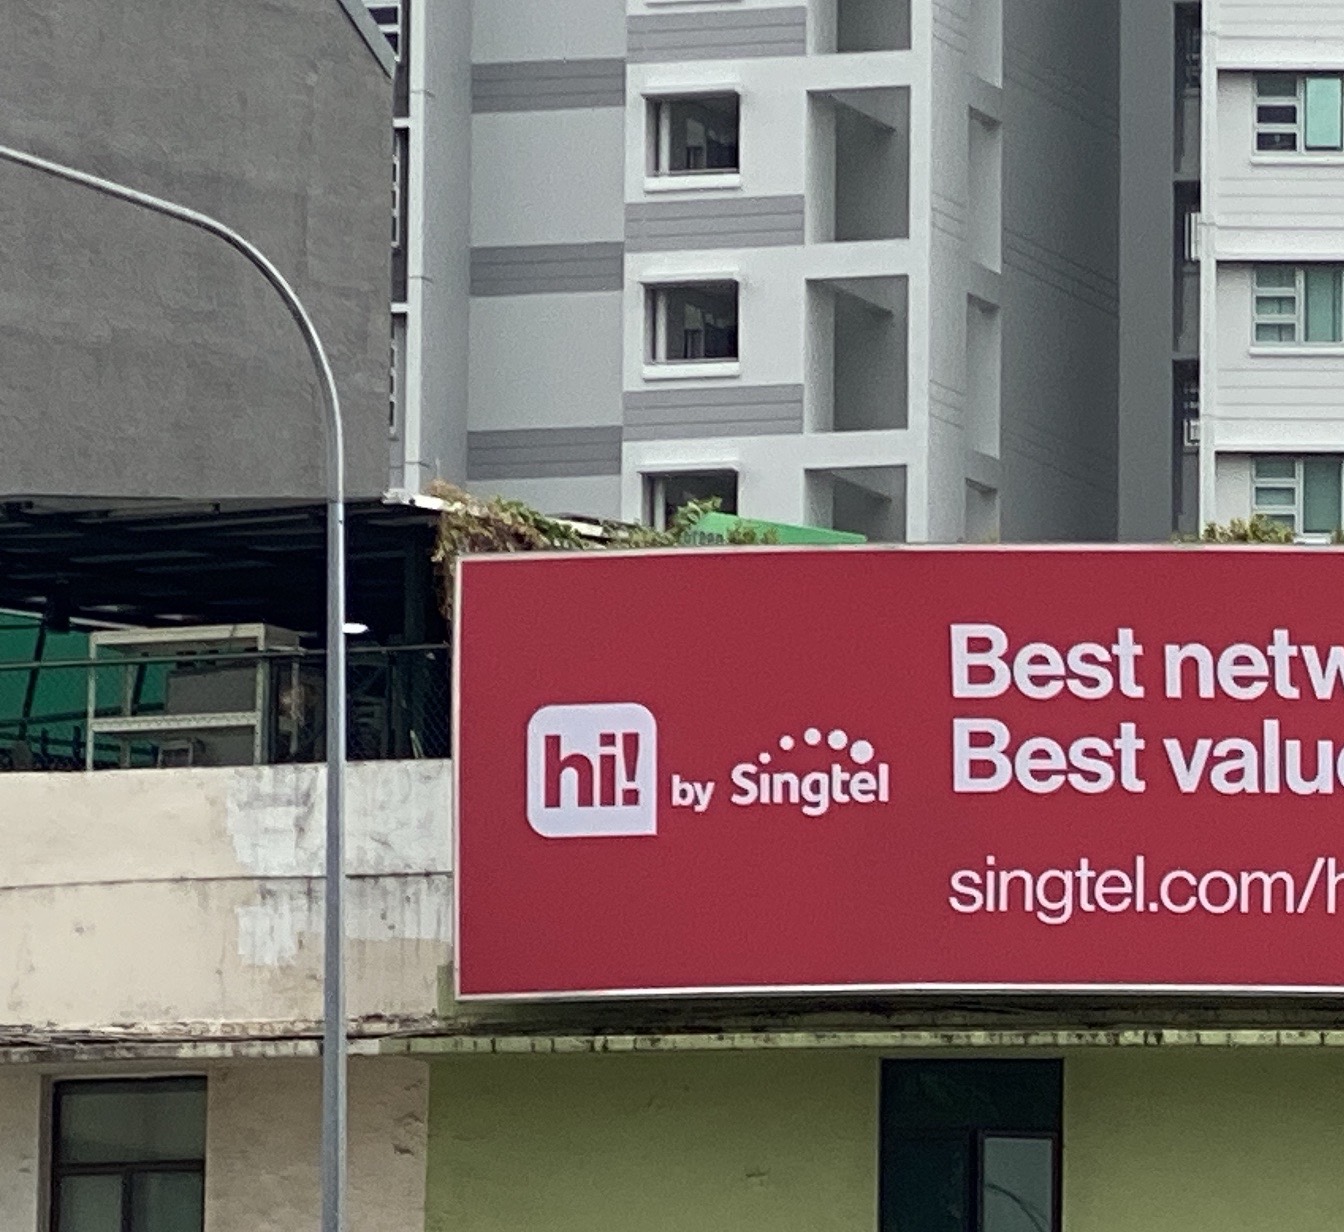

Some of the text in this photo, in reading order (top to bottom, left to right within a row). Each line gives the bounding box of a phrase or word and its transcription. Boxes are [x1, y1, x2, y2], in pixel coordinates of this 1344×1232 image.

[949, 622, 1146, 702] Best
[670, 774, 714, 813] by
[730, 761, 890, 817] Singtel
[951, 716, 1147, 796] Best
